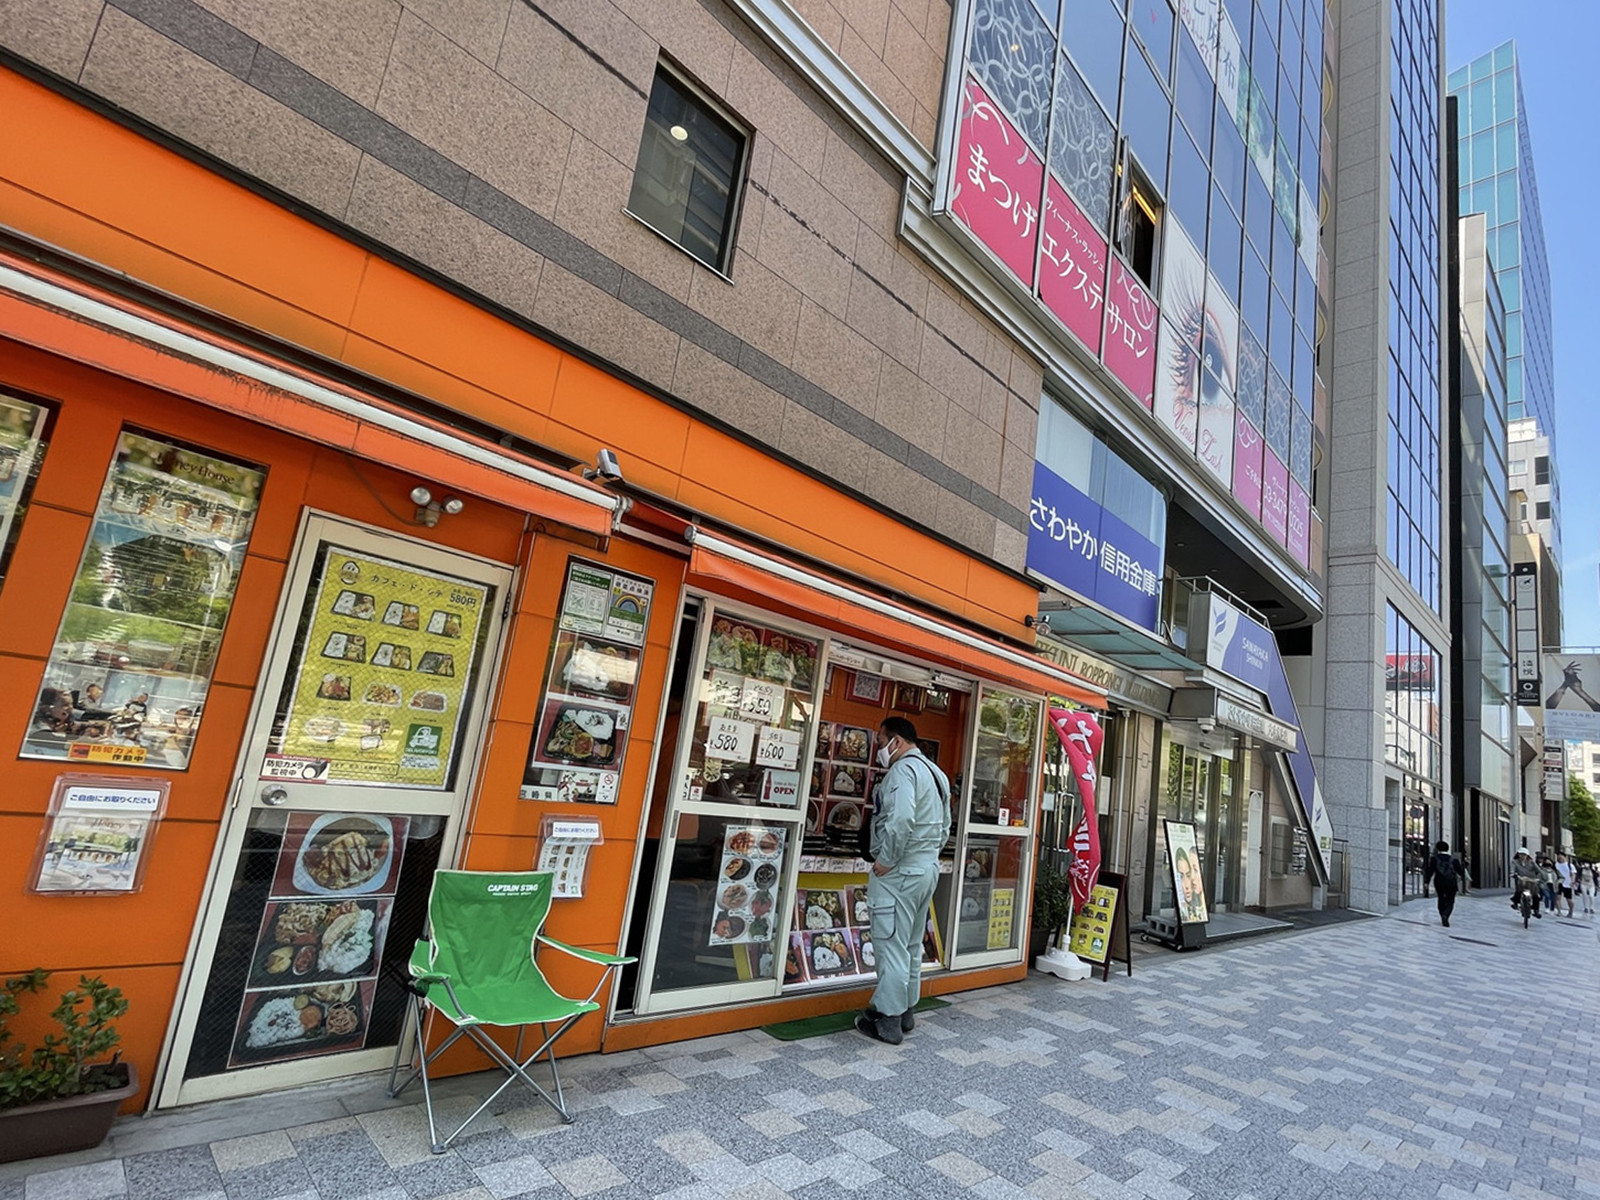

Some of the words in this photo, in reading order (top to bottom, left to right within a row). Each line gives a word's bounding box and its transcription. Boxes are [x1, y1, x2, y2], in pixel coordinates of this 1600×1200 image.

[1029, 496, 1157, 597] さわやか信用金庫
[449, 592, 477, 608] 580円
[91, 745, 146, 755] 防犯カメラ
[266, 759, 304, 770] 防犯カメラ
[774, 786, 795, 795] OPEN
[70, 793, 156, 805] ご自由にお取りください
[487, 884, 519, 892] CAPTAIN
[520, 884, 538, 892] STAG
